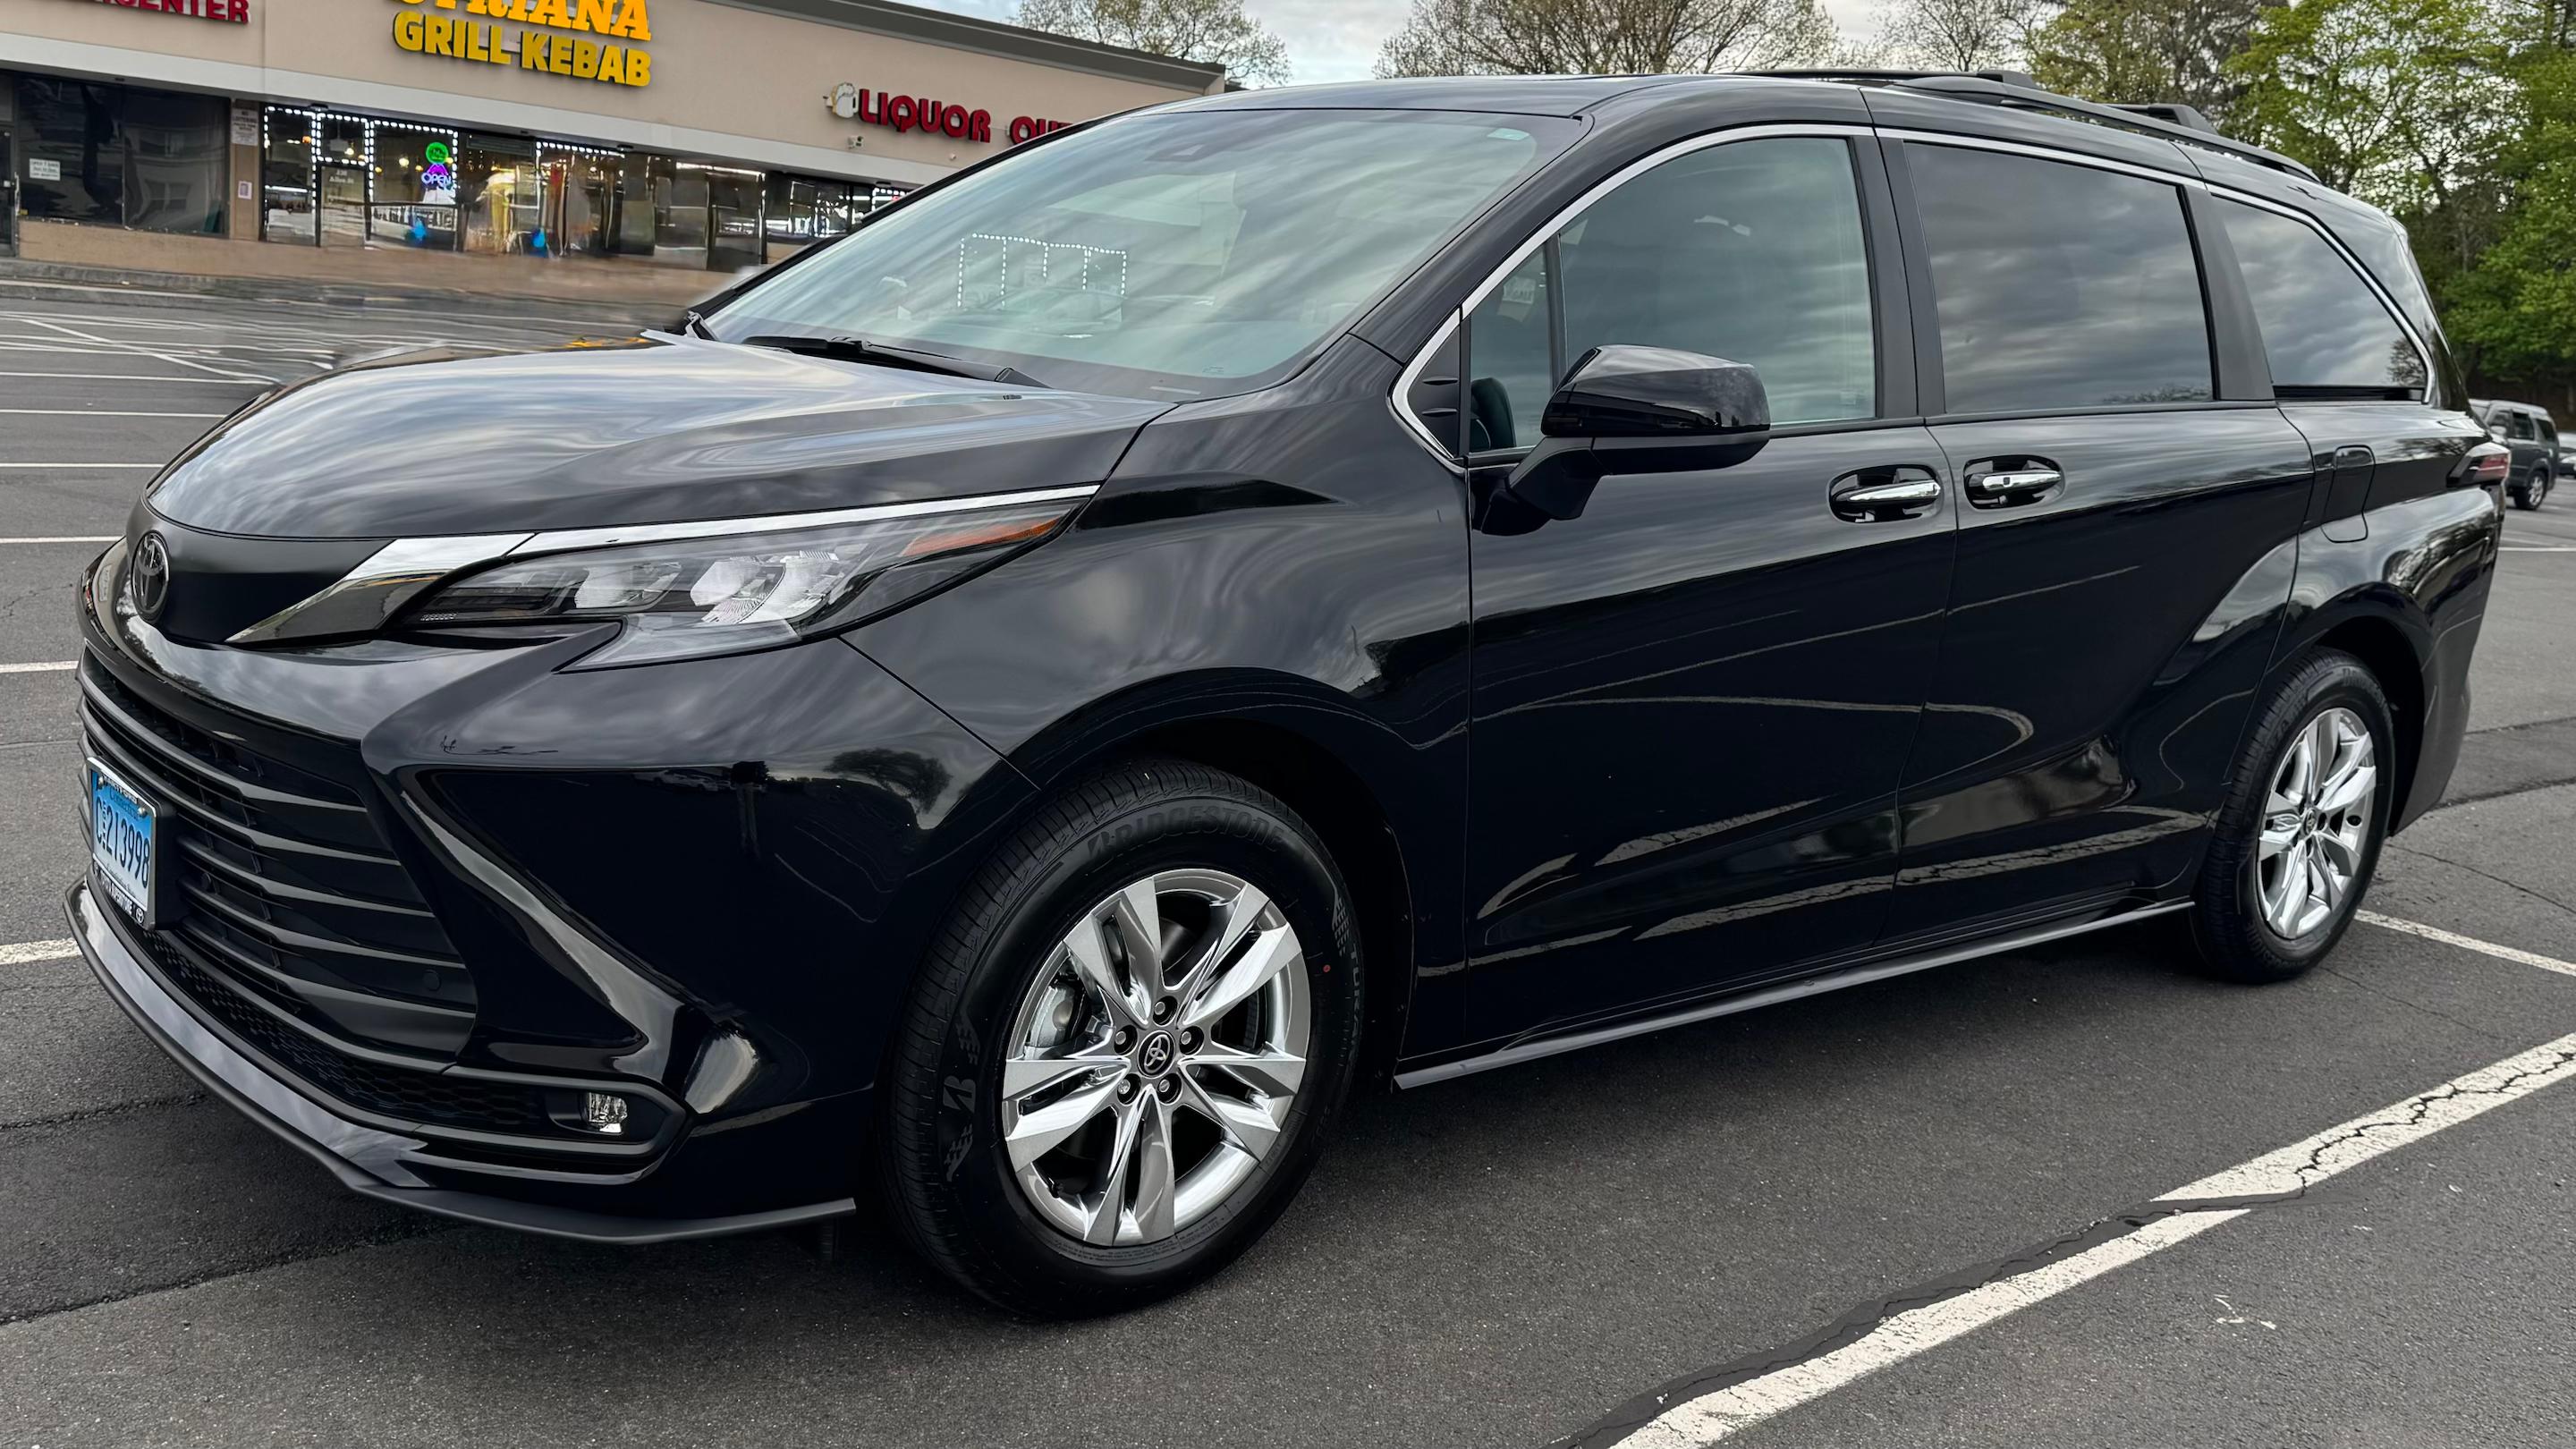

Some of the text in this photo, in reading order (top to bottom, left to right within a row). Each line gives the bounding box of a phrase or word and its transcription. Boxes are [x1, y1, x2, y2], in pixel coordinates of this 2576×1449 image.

[402, 0, 652, 41] IANA
[394, 11, 652, 87] GRILL KEBAB
[858, 89, 991, 143] LIQUOR
[421, 173, 452, 186] OPEN
[106, 805, 150, 889] 213998
[1086, 805, 1286, 859] BRIDGESTONE
